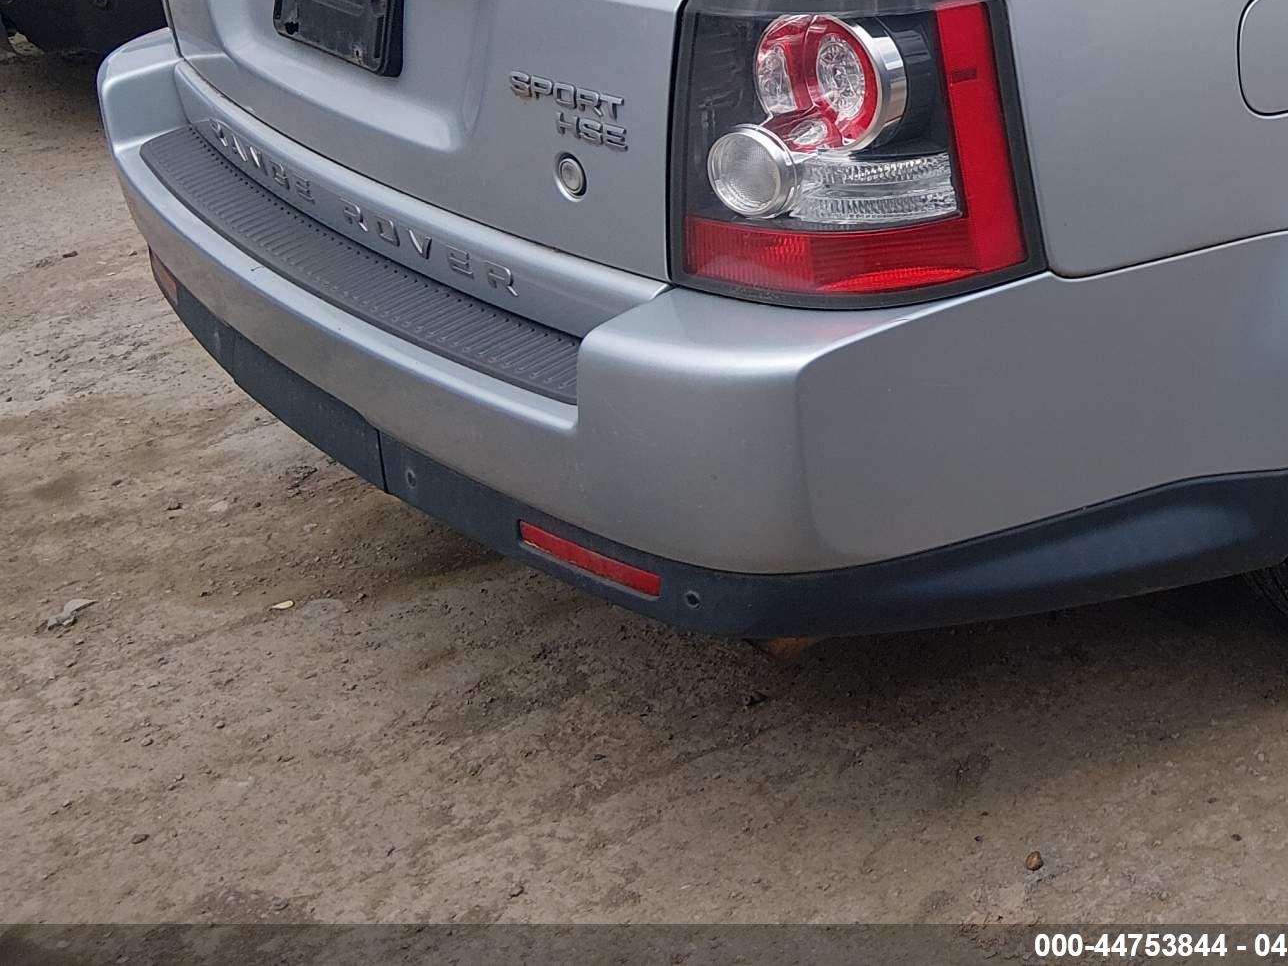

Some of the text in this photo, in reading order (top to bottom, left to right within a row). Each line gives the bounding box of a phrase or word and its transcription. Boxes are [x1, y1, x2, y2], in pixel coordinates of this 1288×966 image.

[510, 70, 625, 121] SPORT
[556, 112, 629, 152] HSE
[209, 118, 520, 298] RANGE ROVER
